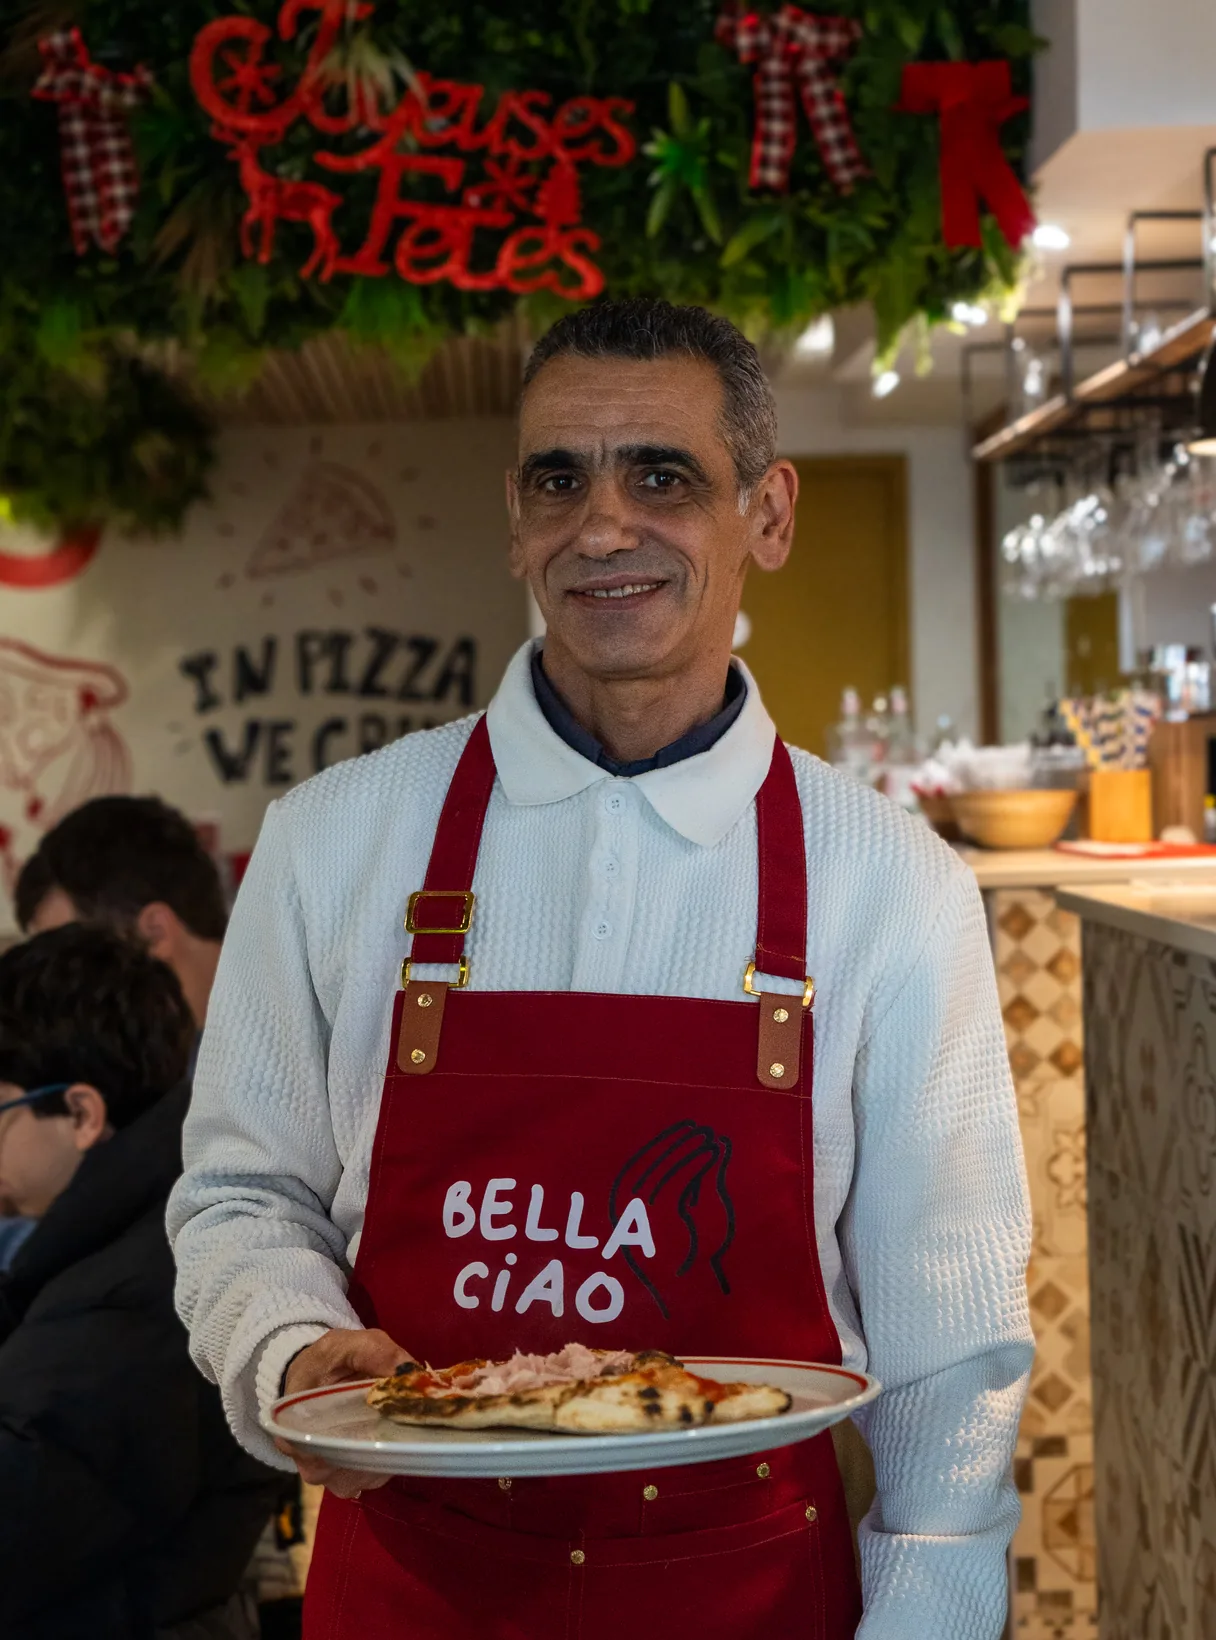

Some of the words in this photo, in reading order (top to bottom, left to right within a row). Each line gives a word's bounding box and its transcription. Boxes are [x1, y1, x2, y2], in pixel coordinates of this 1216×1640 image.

[179, 636, 279, 715] IN
[295, 625, 478, 707] PIZZA
[205, 718, 297, 787] WE
[443, 1178, 656, 1260] BELLA
